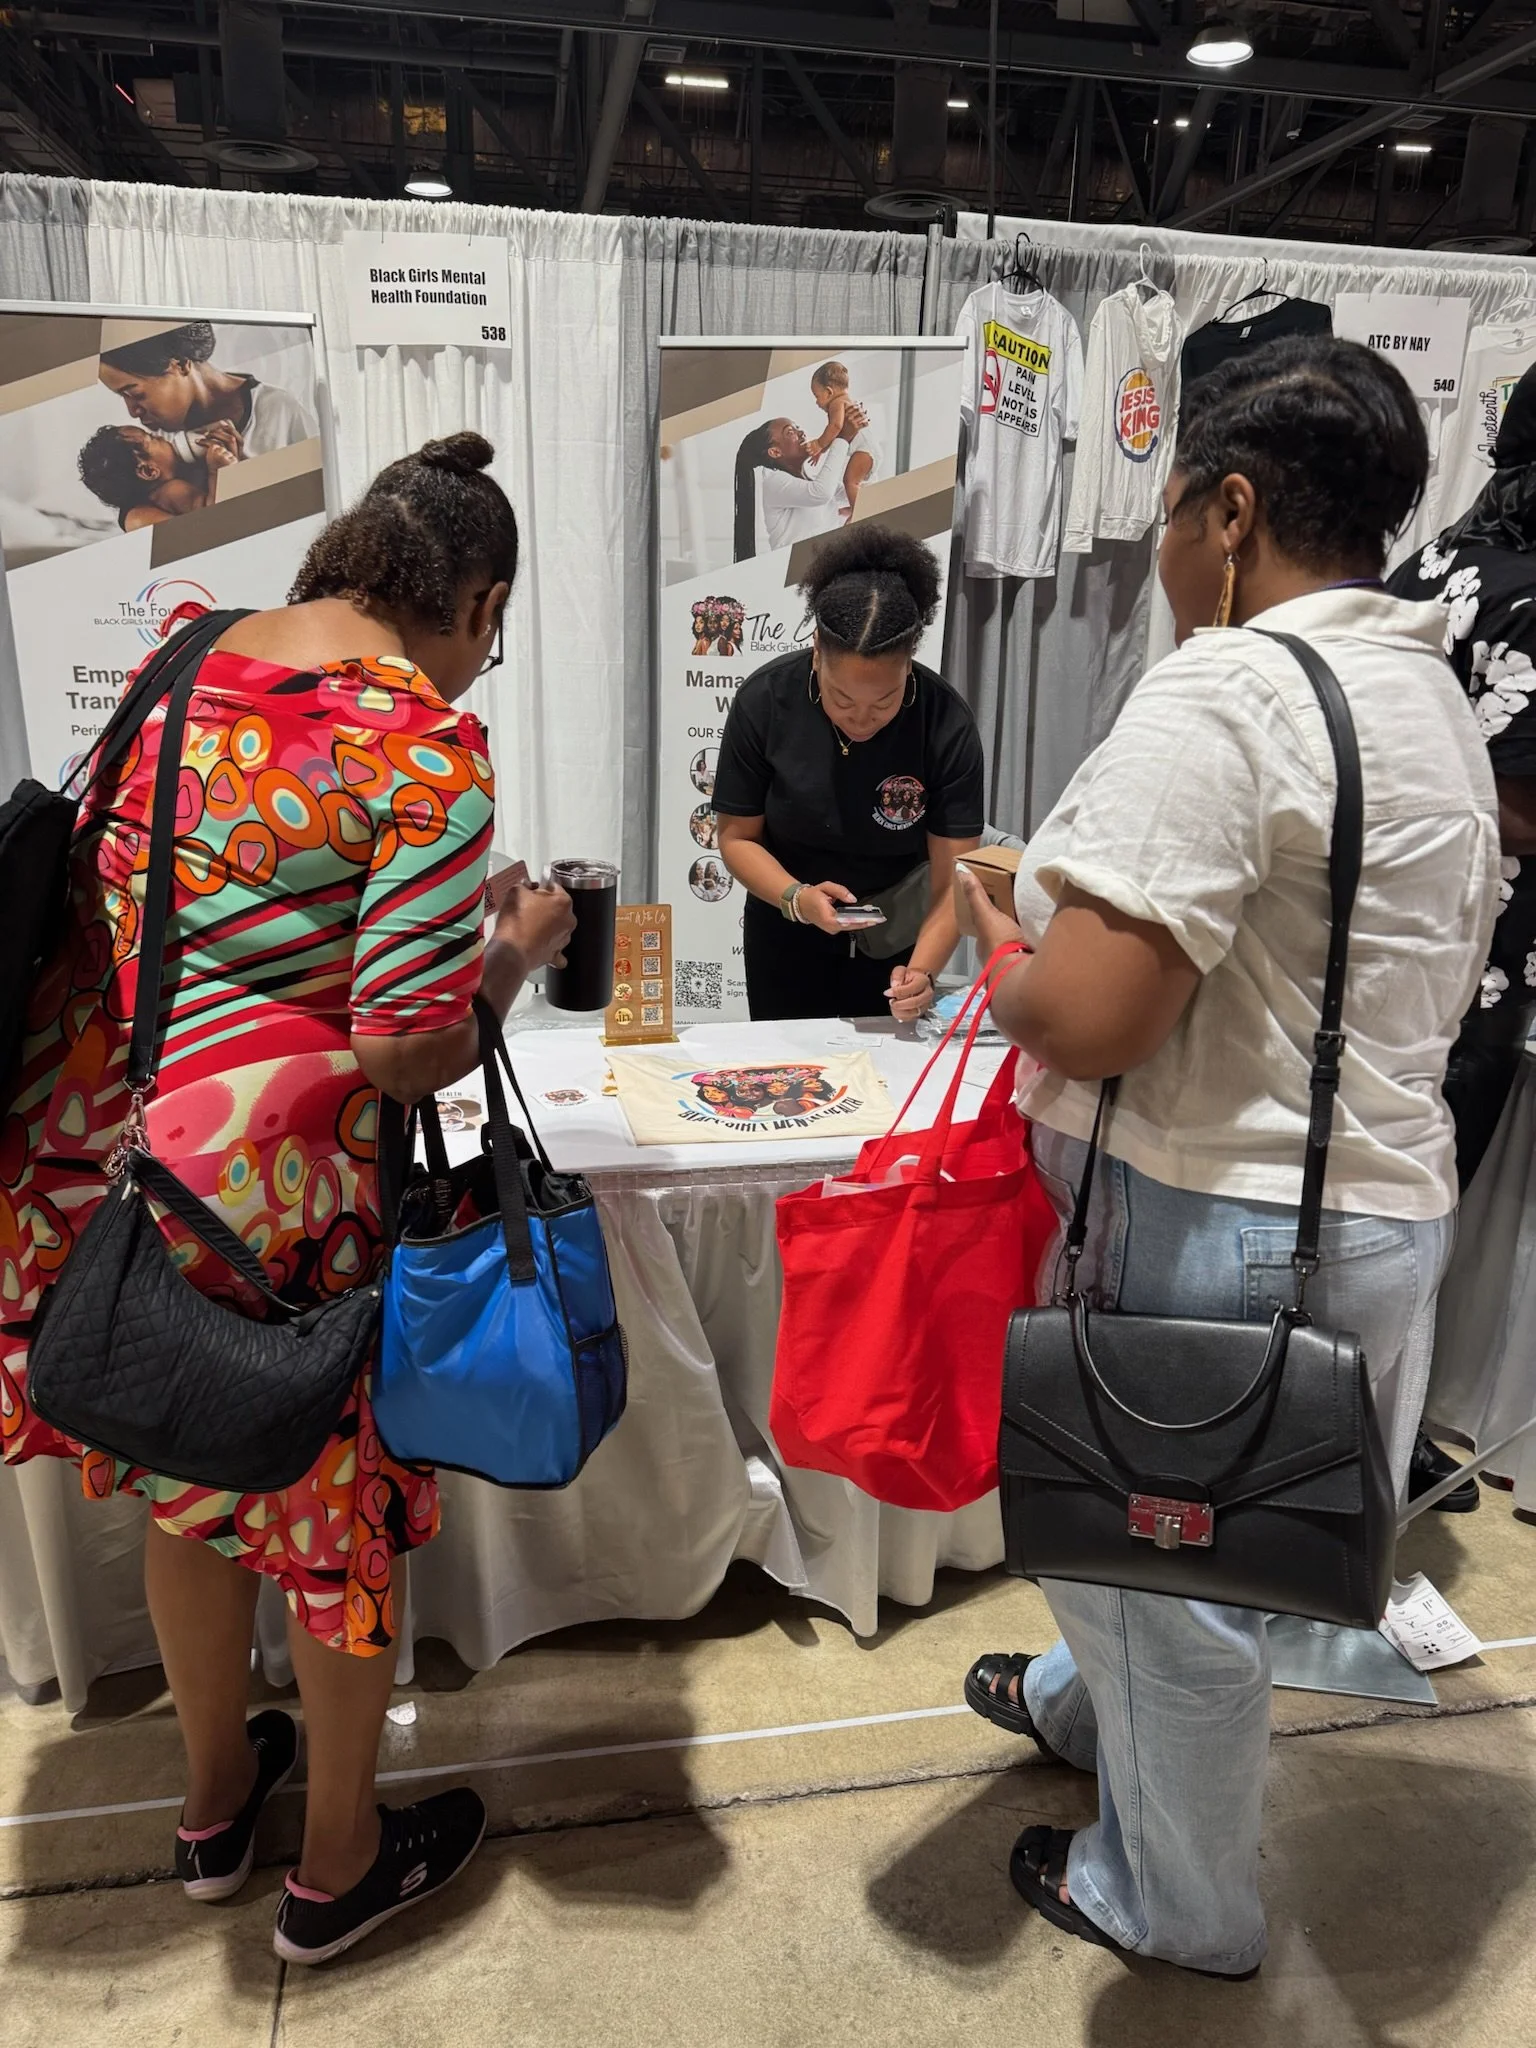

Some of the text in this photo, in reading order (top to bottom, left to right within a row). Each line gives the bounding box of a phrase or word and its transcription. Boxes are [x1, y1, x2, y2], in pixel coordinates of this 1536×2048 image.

[370, 269, 485, 284] Black Girls Mental
[371, 290, 486, 305] Health Foundation
[482, 326, 506, 340] 538
[993, 330, 1049, 369] CAUTION
[1368, 335, 1430, 351] ATC BY NAY
[1008, 380, 1037, 402] LEVEL
[1434, 379, 1454, 392] 540
[1002, 396, 1024, 413] NOT
[1120, 406, 1161, 440] KING
[118, 602, 145, 616] The
[745, 613, 786, 642] The
[750, 641, 776, 652] Black
[777, 642, 798, 653] Girls
[65, 692, 122, 709] Tran
[687, 727, 714, 738] OUR
[727, 988, 743, 997] sign
